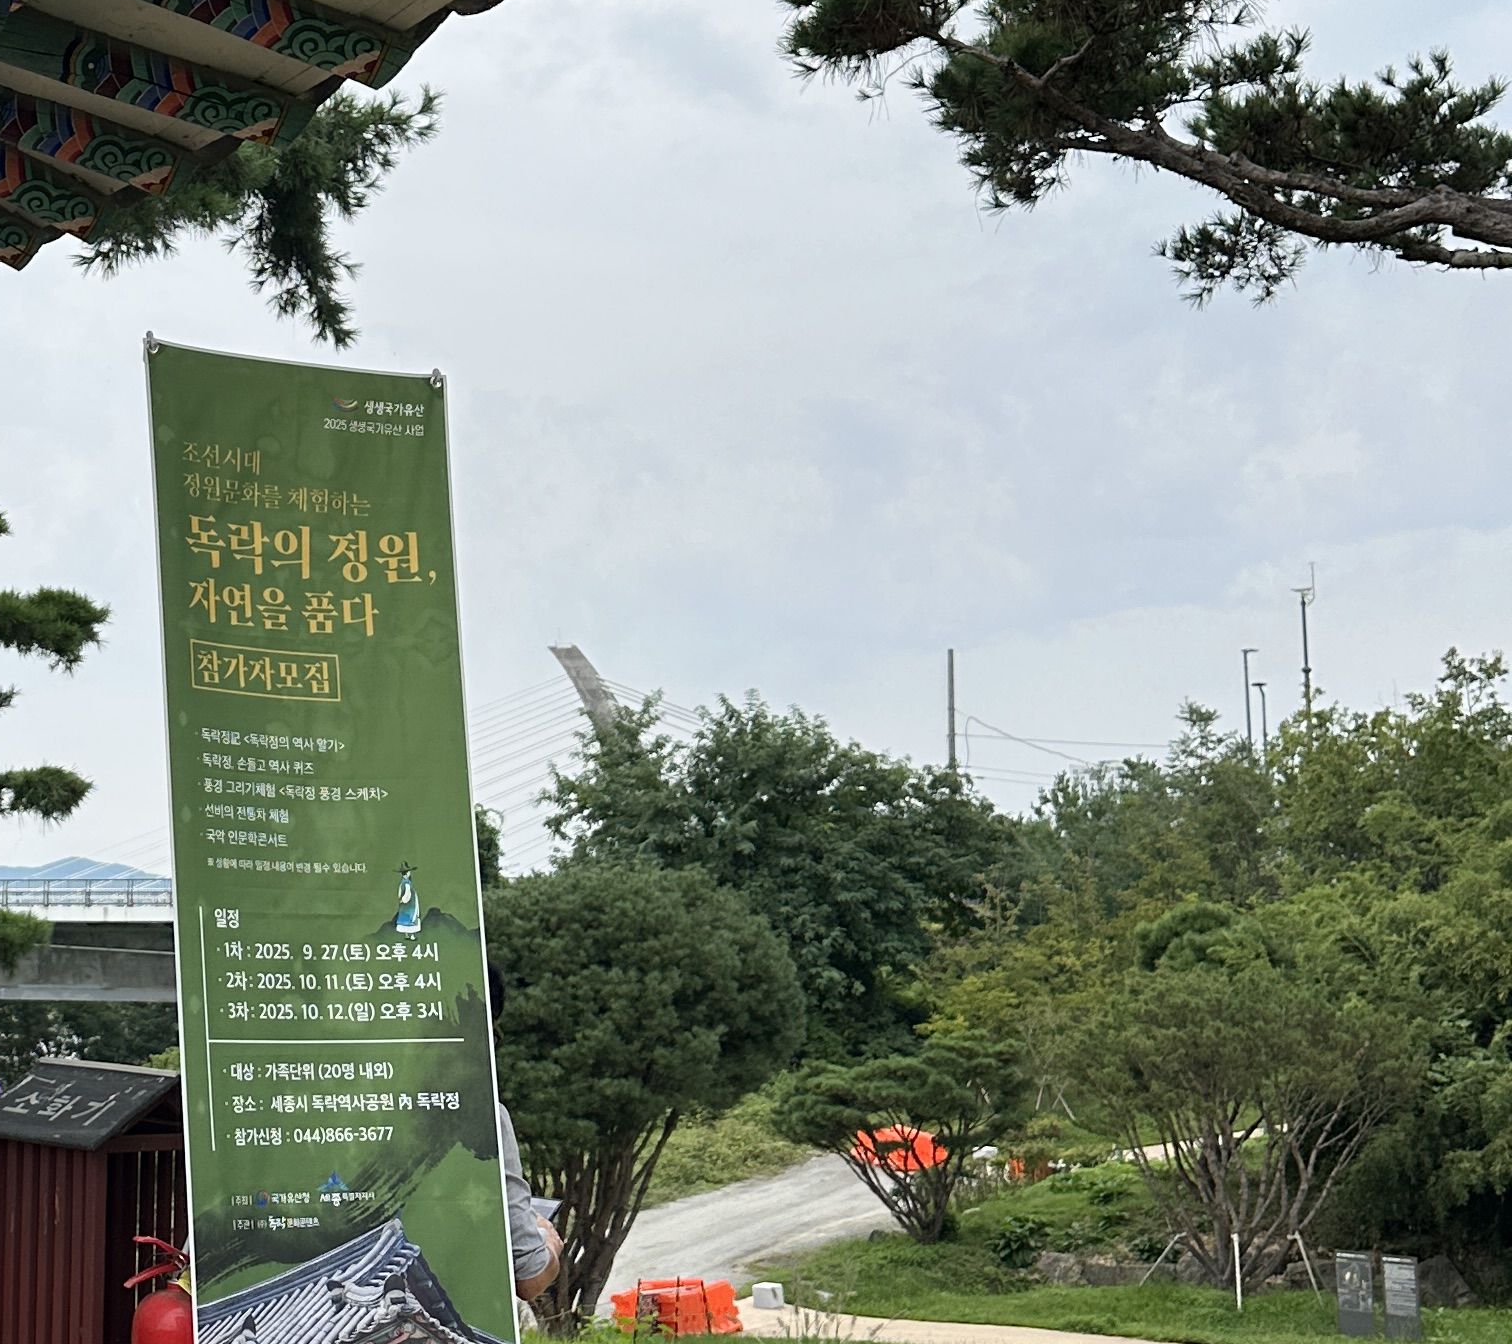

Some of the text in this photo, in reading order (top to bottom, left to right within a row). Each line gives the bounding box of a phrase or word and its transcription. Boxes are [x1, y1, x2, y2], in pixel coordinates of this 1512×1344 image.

[364, 400, 424, 417] 생생국가유산
[323, 418, 347, 430] 2025
[405, 424, 424, 436] 사업
[182, 440, 261, 475] 조선시대
[183, 472, 371, 517] 정원문화를 체험하는
[185, 514, 437, 586] 독락의 정원,
[188, 577, 380, 637] 자연을 품다
[197, 650, 330, 694] 참가자모집
[292, 737, 314, 751] 역사
[268, 759, 290, 774] 역사
[293, 760, 314, 775] 퀴즈
[203, 778, 223, 793] 풍경
[319, 786, 341, 801] 풍경
[205, 804, 234, 819] 선비의
[269, 808, 289, 824] 체험
[205, 828, 225, 844] 국악
[214, 908, 239, 929] 일정
[254, 943, 293, 960] 2025.
[302, 944, 317, 960] 9.
[376, 943, 408, 962] 오후
[412, 942, 439, 961] 4시
[257, 973, 295, 990] 2025.
[299, 974, 321, 990] 10.
[378, 972, 410, 991] 오후
[414, 971, 441, 991] 4시
[259, 1003, 298, 1020] 2025.
[301, 1004, 323, 1020] 10.
[380, 1001, 413, 1021] 오후
[417, 1001, 443, 1021] 3시
[264, 1062, 314, 1081] 가족단위
[318, 1062, 355, 1080] (20명
[359, 1062, 394, 1080] 내외)
[2, 1091, 118, 1126] 소화기
[270, 1094, 308, 1113] 세종시
[312, 1093, 394, 1112] 독락역사공원
[416, 1091, 460, 1111] 독락정
[234, 1127, 282, 1146] 참가신청
[293, 1126, 394, 1145] 044)866-3677
